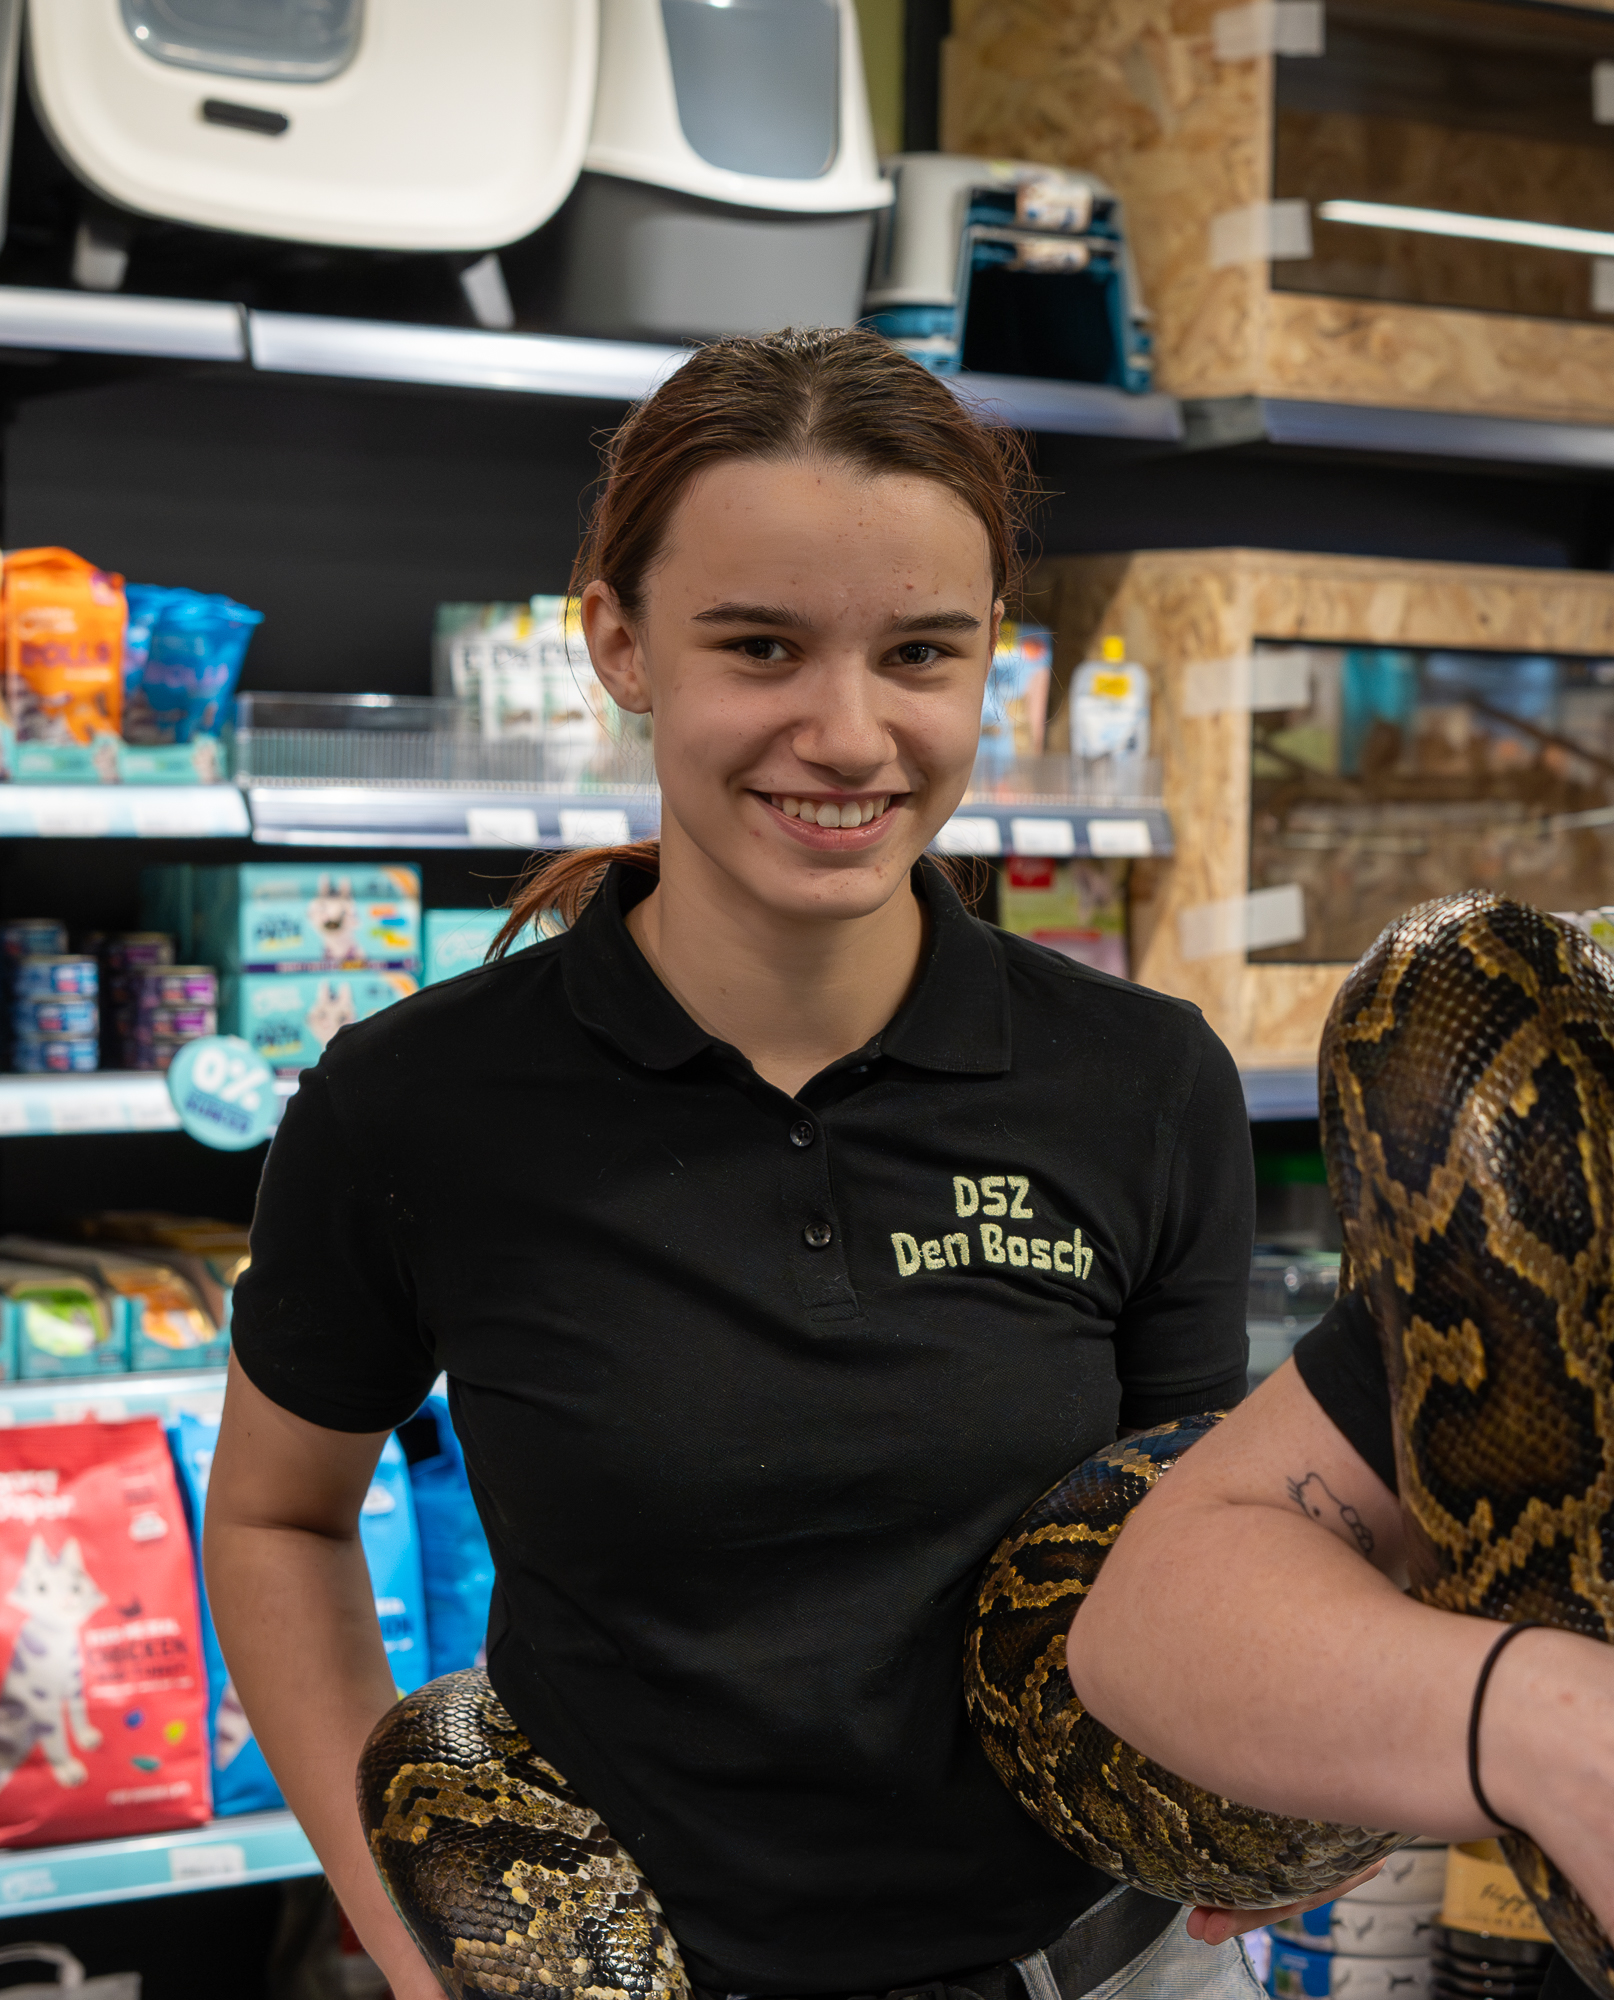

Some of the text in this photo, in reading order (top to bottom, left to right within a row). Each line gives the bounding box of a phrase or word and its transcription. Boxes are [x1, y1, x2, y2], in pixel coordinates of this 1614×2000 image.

[191, 1045, 269, 1112] 0%
[952, 1175, 1034, 1219] DSZ
[890, 1223, 1094, 1280] Den Bosch
